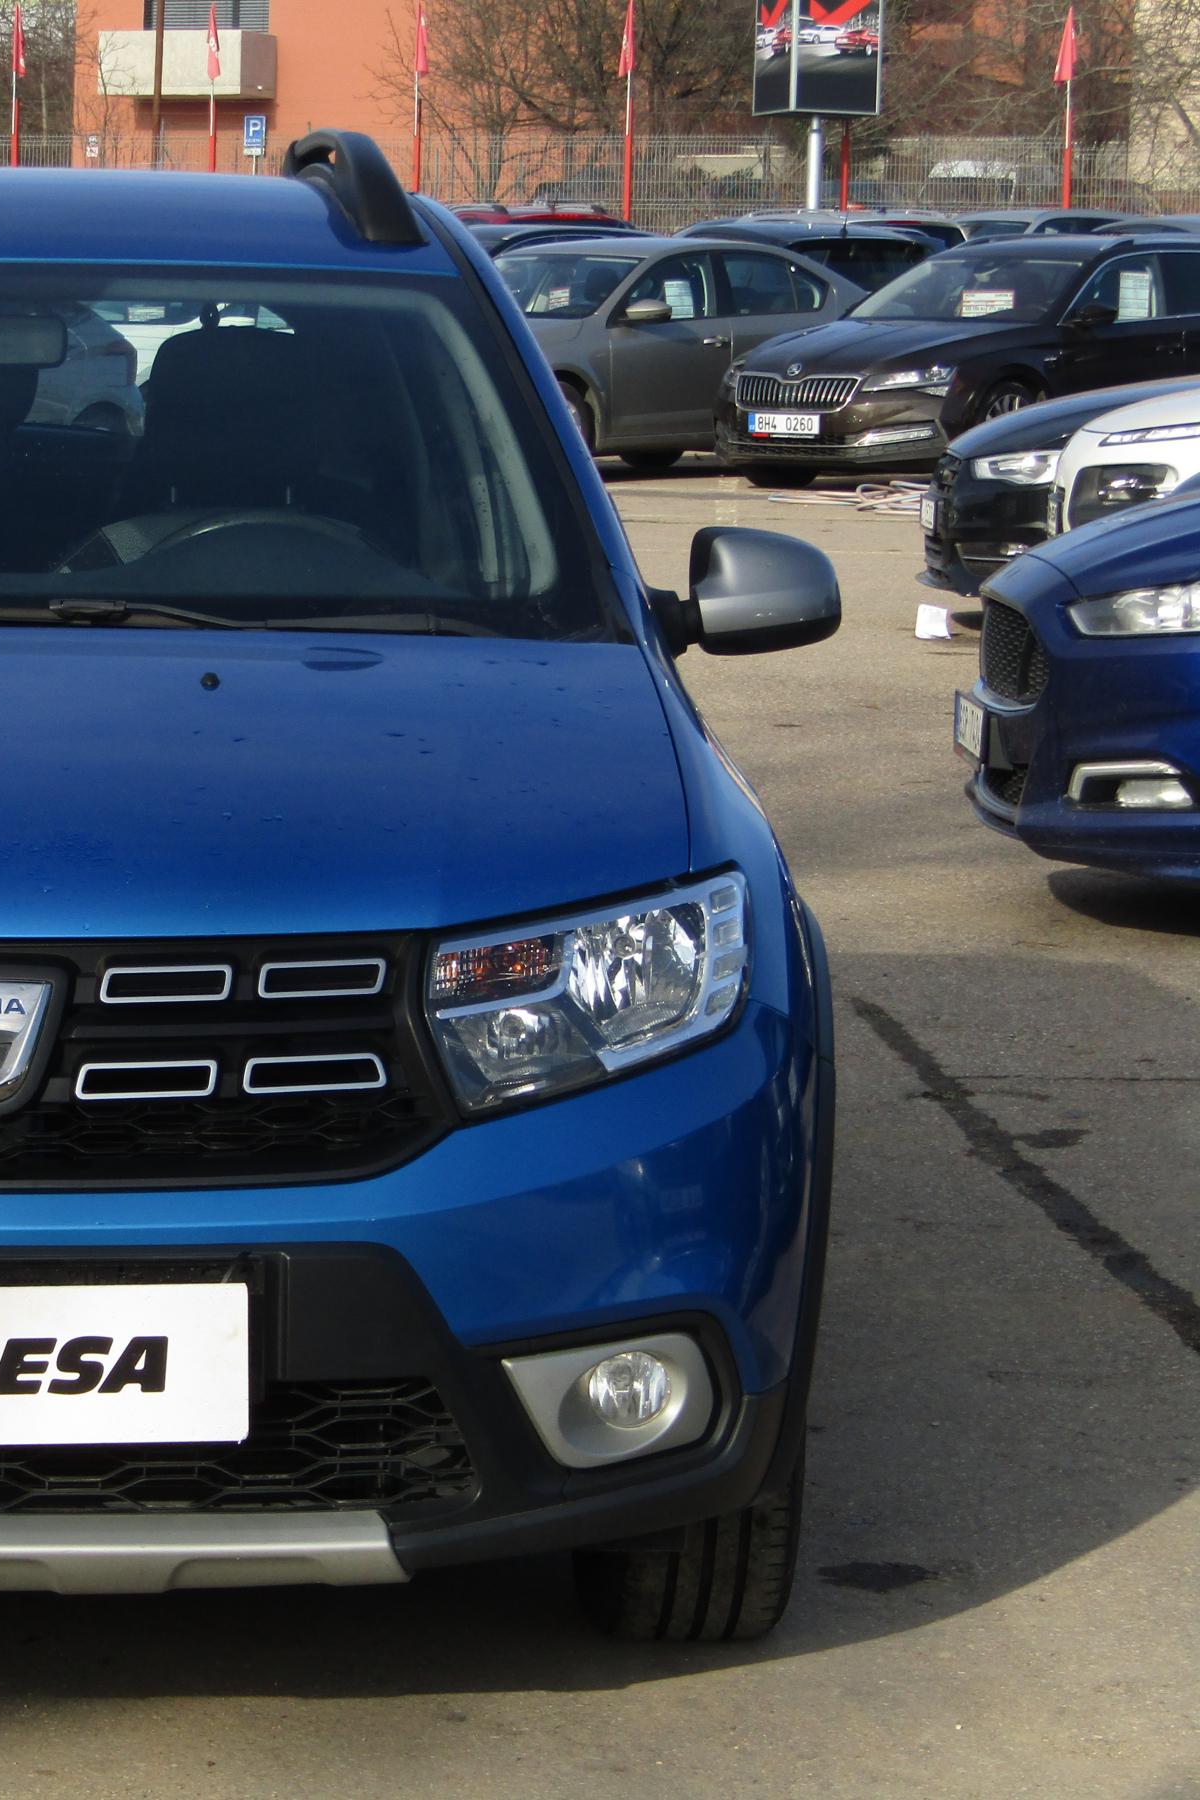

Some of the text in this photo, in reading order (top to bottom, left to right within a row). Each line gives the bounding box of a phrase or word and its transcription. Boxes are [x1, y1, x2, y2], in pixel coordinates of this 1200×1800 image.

[249, 119, 262, 137] P
[757, 416, 814, 432] 8H4 0260
